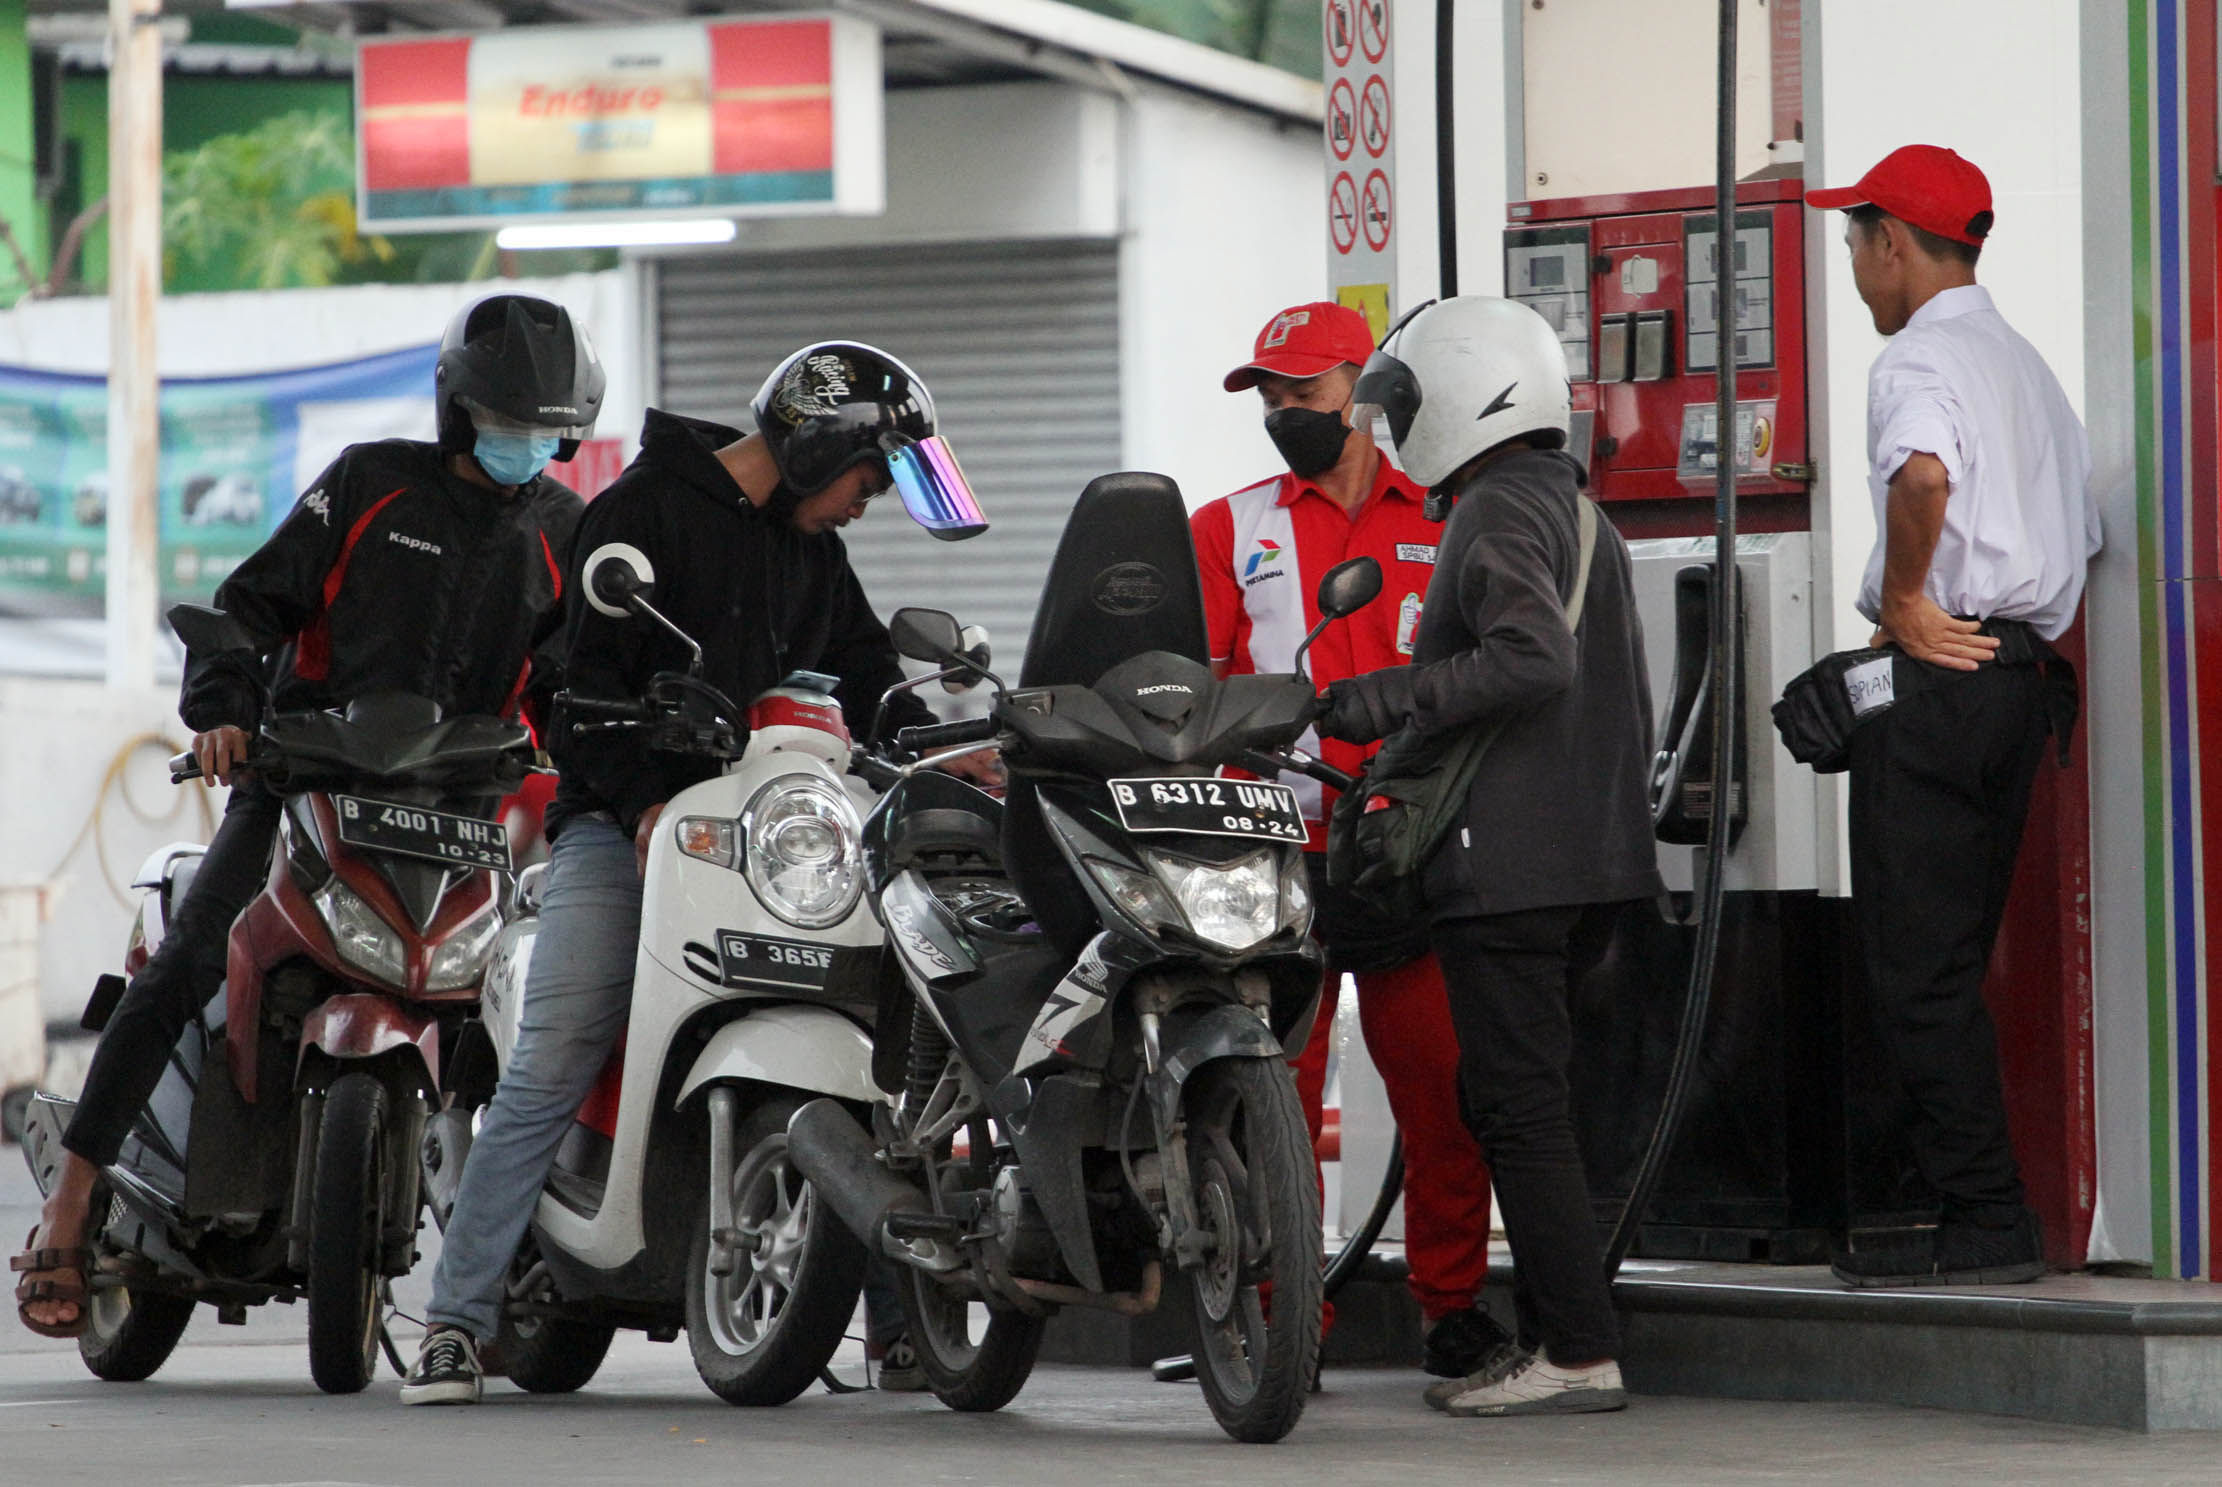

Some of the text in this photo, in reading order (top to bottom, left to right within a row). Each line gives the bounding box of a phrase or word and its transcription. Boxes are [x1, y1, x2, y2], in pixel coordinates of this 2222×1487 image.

[518, 83, 665, 118] Enduro
[807, 355, 850, 405] Racing
[538, 406, 578, 415] HONDA
[389, 531, 442, 555] Kappa
[1137, 684, 1192, 695] HONDA
[1117, 783, 1292, 813] B 6312 UMV
[344, 799, 506, 847] B 4001 NHJ
[728, 941, 749, 958] B
[892, 903, 954, 970] BLADE
[1074, 969, 1108, 993] HONDA
